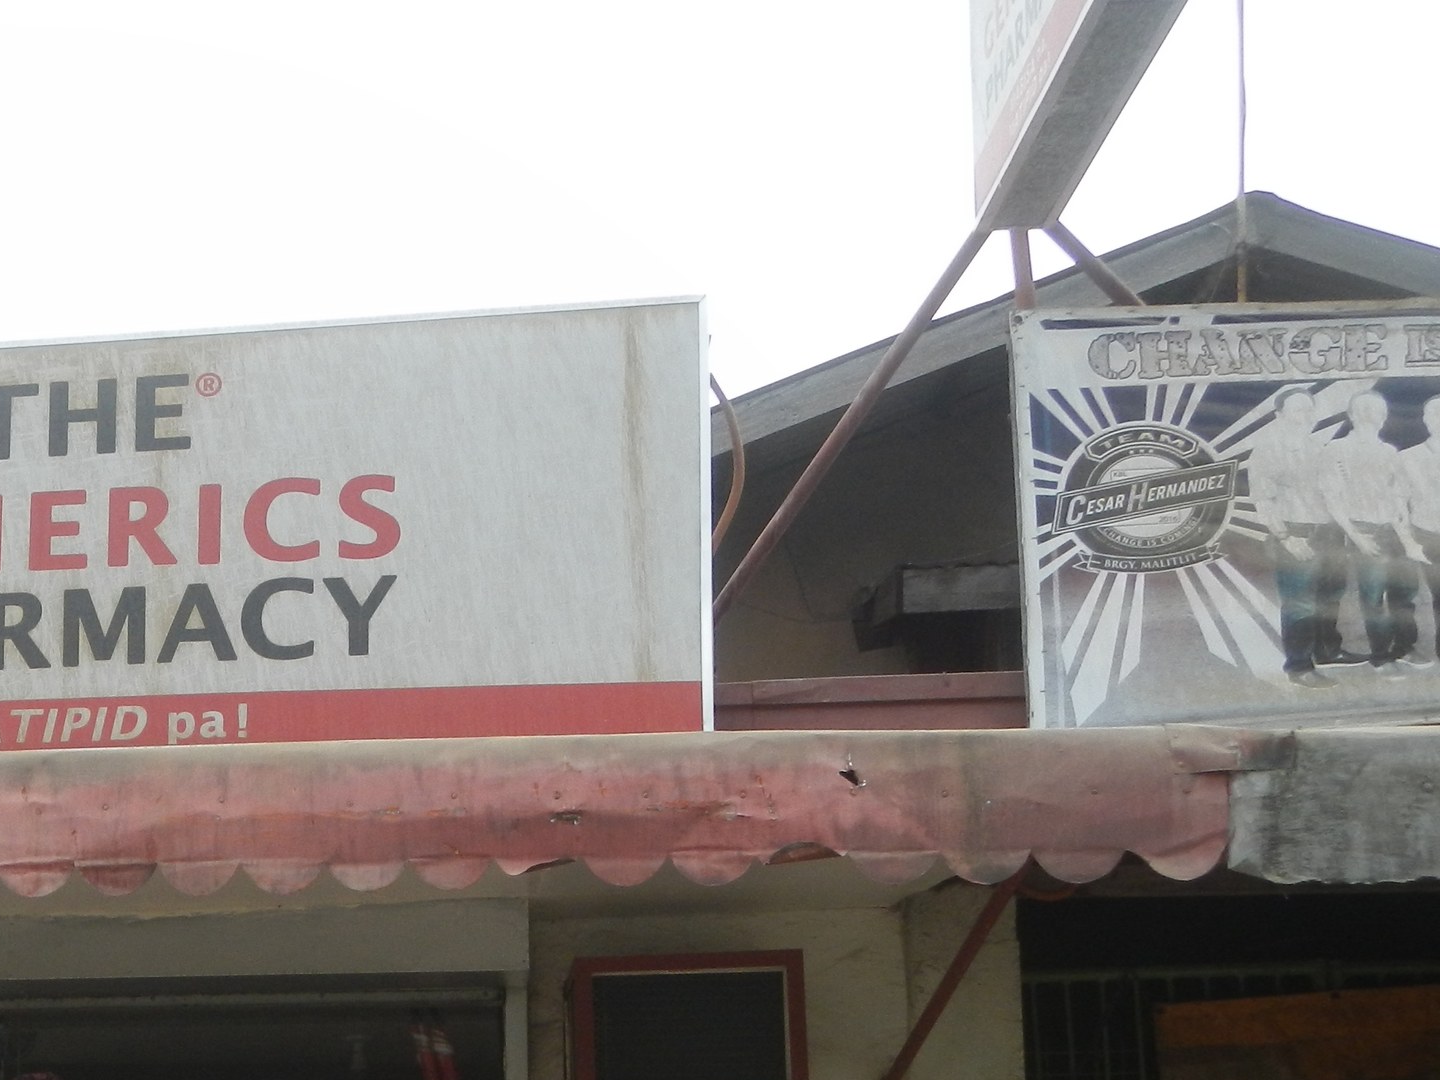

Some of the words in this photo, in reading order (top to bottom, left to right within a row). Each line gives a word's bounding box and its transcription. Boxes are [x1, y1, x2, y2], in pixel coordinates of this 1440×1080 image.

[1088, 324, 1388, 380] CHANGE
[1099, 432, 1185, 449] TEAM
[1066, 493, 1125, 526] CESAR
[1126, 474, 1226, 512] HERNANDEZ
[1103, 527, 1141, 547] CHANGE
[1104, 559, 1137, 569] BRGY.
[1140, 553, 1196, 569] MALITLIT
[167, 703, 250, 746] pa!
